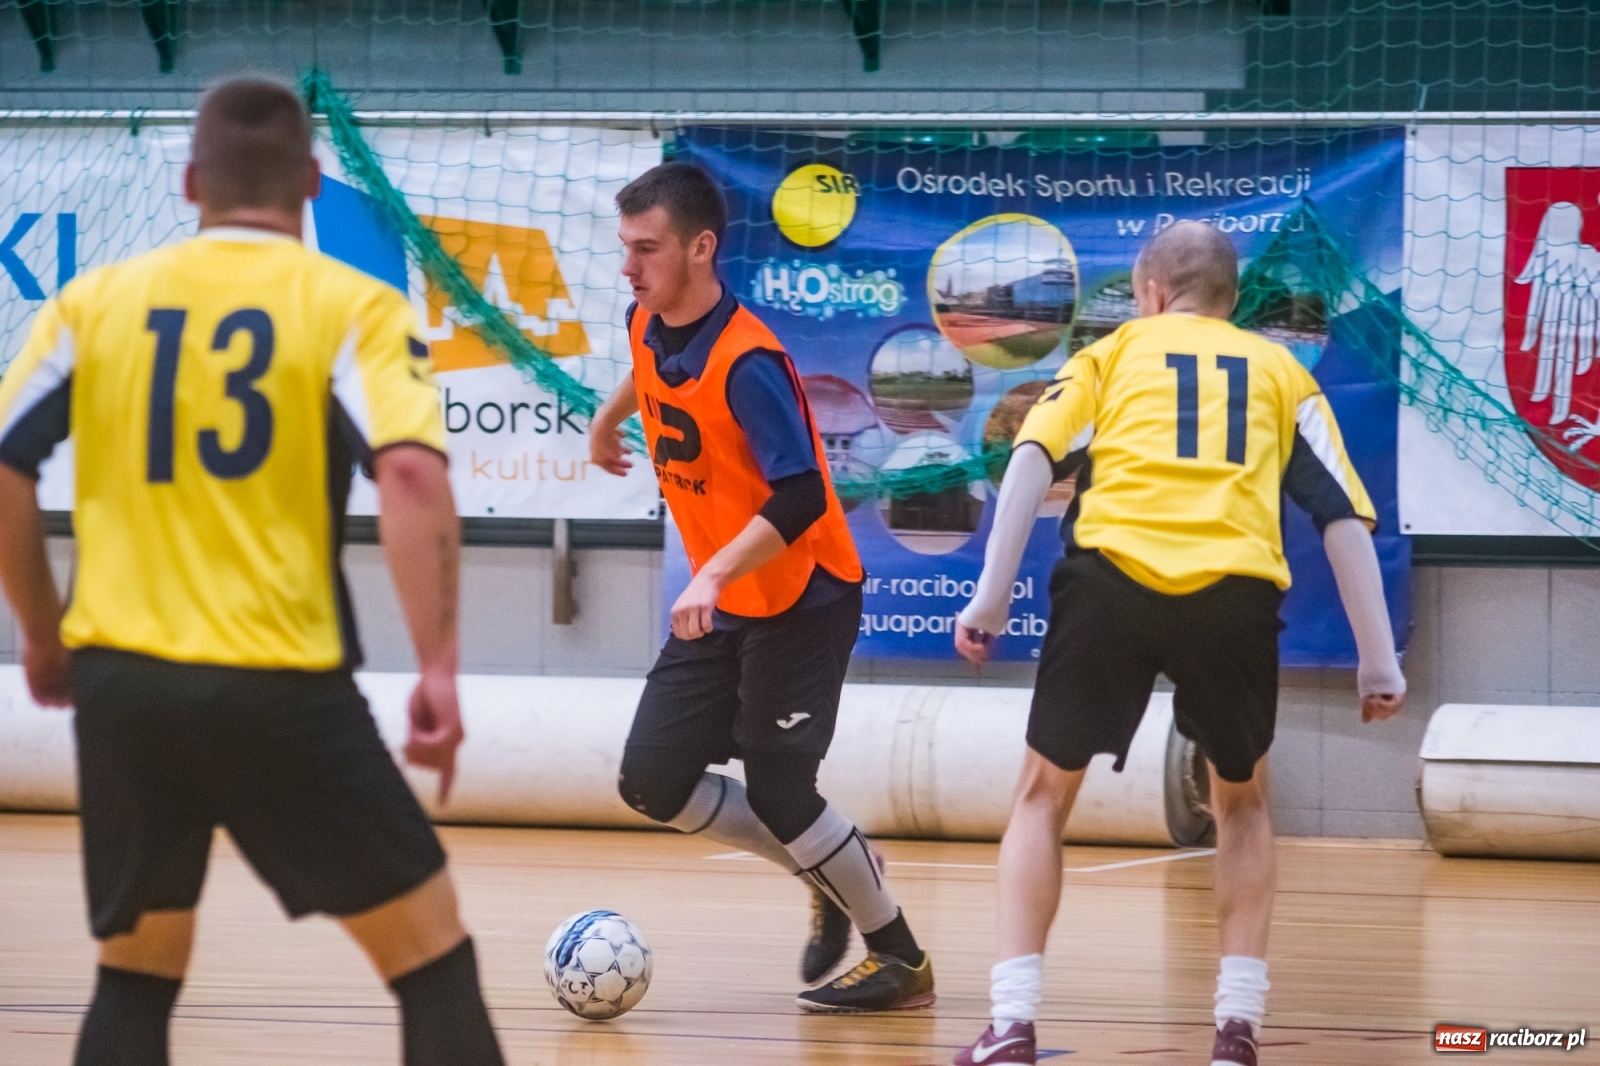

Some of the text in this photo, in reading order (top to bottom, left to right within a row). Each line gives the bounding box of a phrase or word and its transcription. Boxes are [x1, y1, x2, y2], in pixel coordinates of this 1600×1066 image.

[815, 174, 861, 196] SIR
[897, 167, 1311, 202] Ośrodek Sportu i Rekreacji
[1117, 212, 1305, 236] w Riborzu
[145, 308, 275, 483] 13
[1165, 353, 1248, 466] 11
